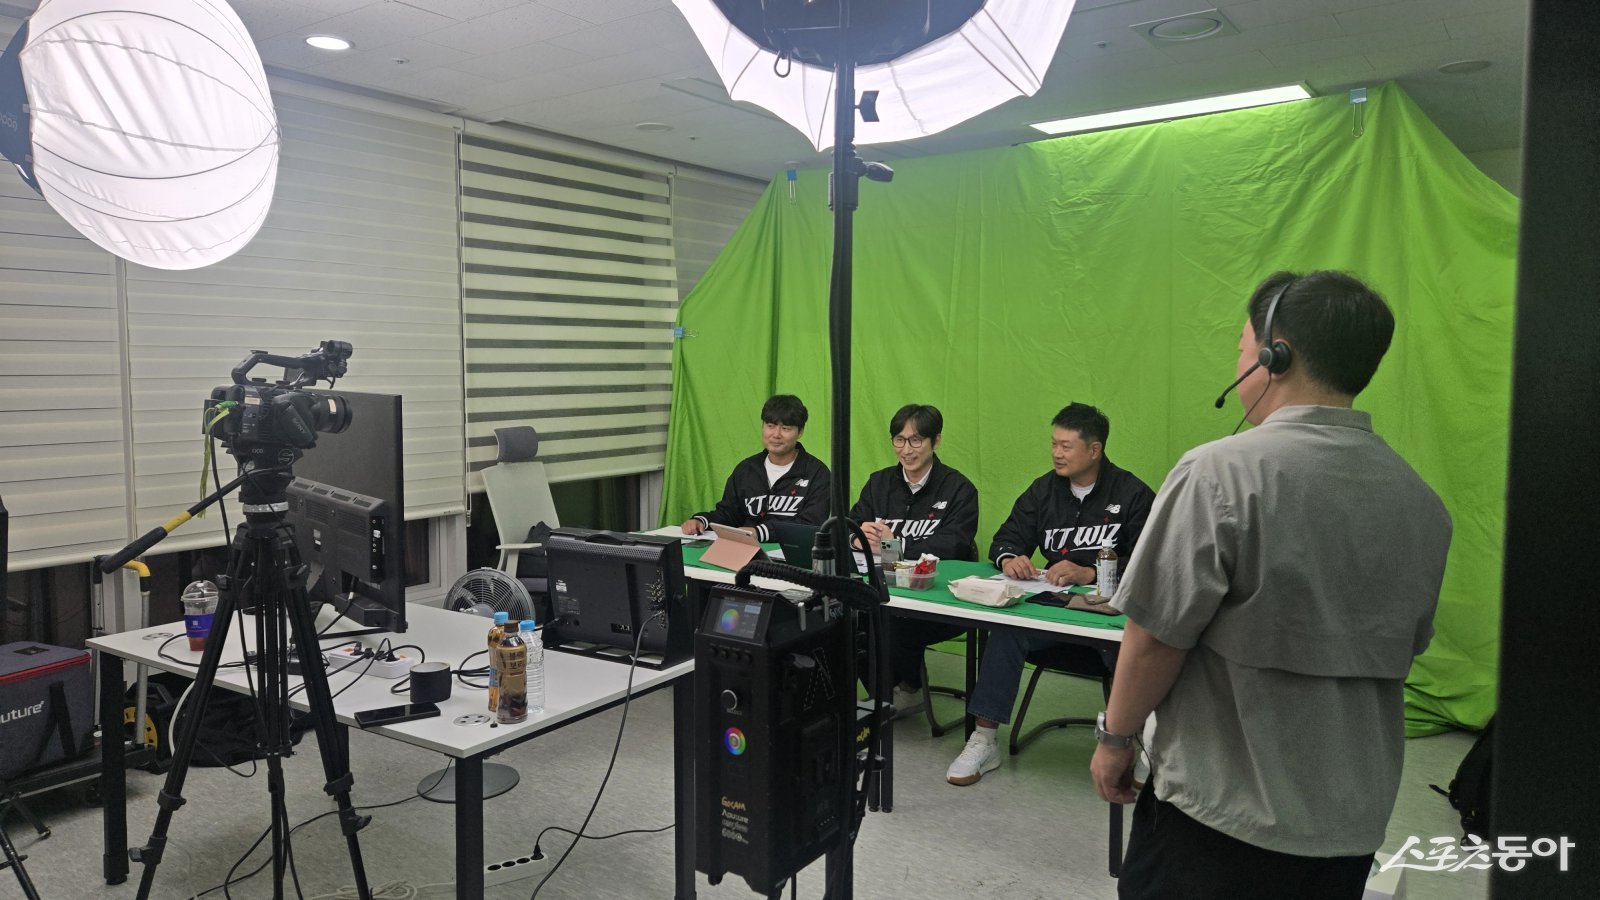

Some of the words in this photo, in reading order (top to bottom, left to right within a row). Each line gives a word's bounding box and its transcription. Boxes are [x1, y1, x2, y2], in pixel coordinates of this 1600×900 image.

[744, 495, 767, 516] KT
[768, 495, 804, 512] WIZ
[875, 517, 903, 533] T
[901, 519, 941, 537] WIZ
[1044, 527, 1075, 552] KT
[1073, 523, 1121, 547] WIZ
[0, 703, 42, 725] uture
